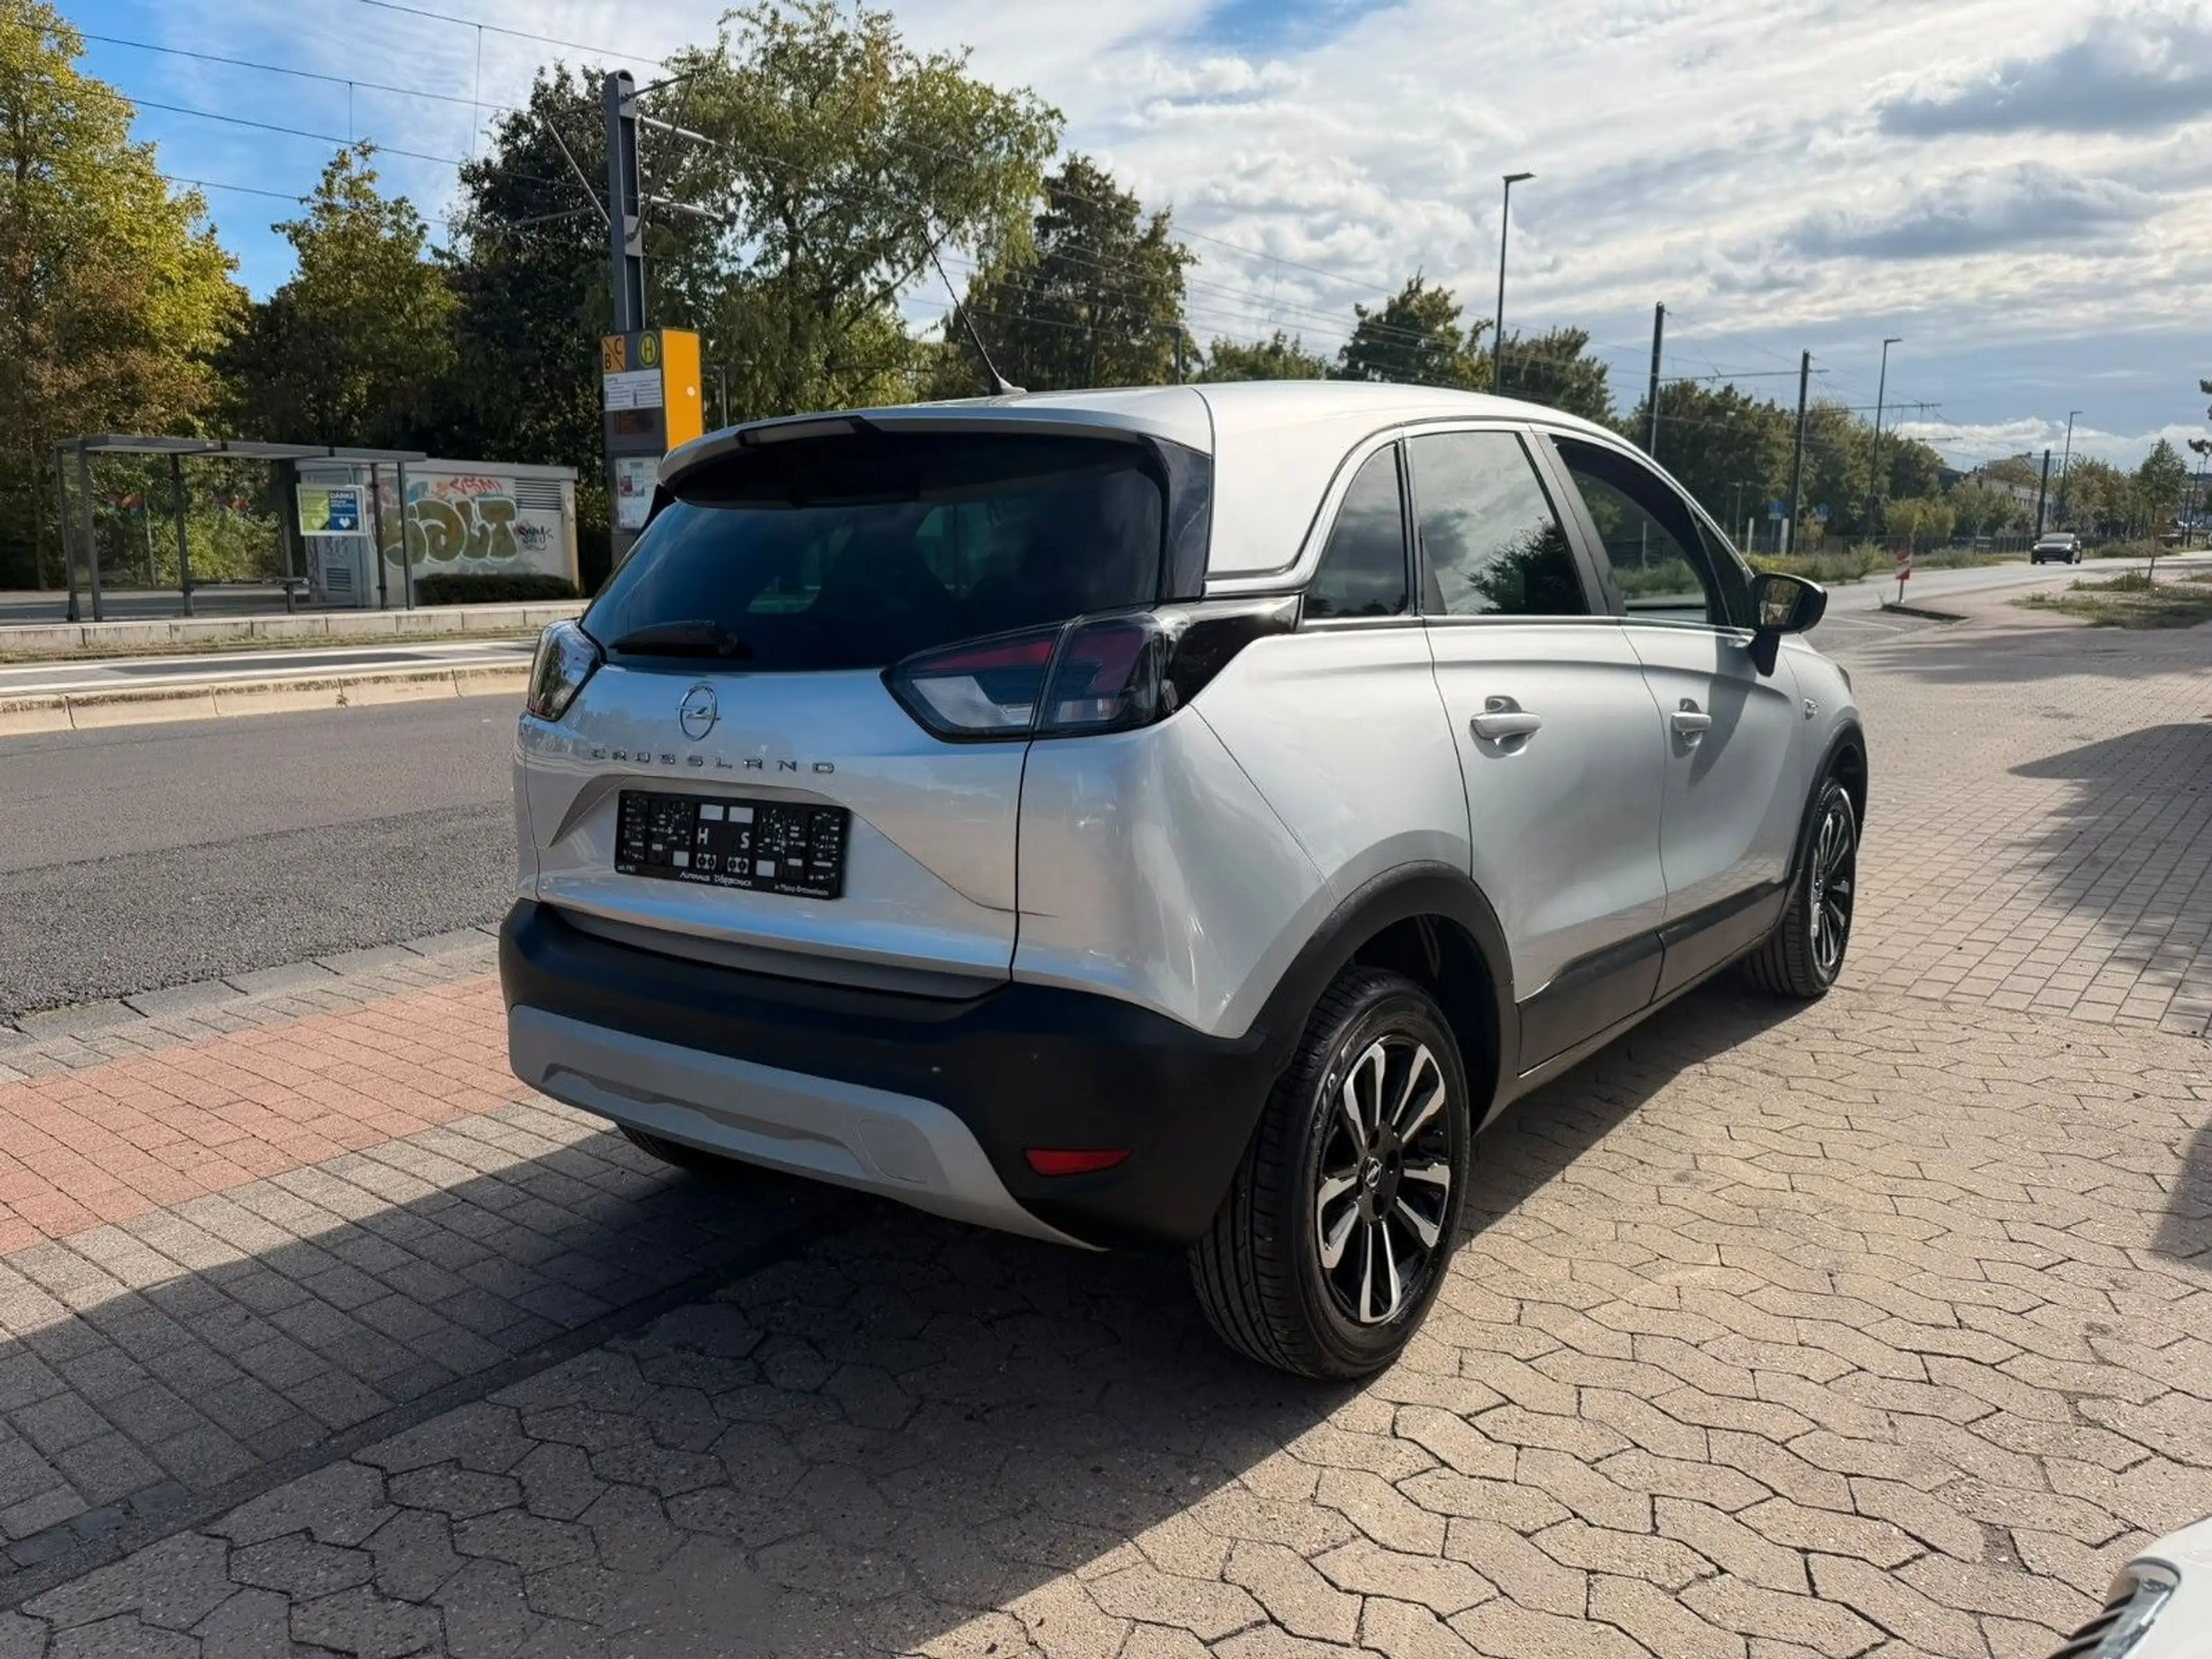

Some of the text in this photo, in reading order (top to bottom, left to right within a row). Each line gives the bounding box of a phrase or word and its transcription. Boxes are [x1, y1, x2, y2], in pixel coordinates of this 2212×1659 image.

[614, 338, 623, 354] C
[643, 340, 653, 359] H
[605, 353, 612, 369] B
[590, 748, 835, 774] CROSSLAND
[697, 827, 750, 849] H S
